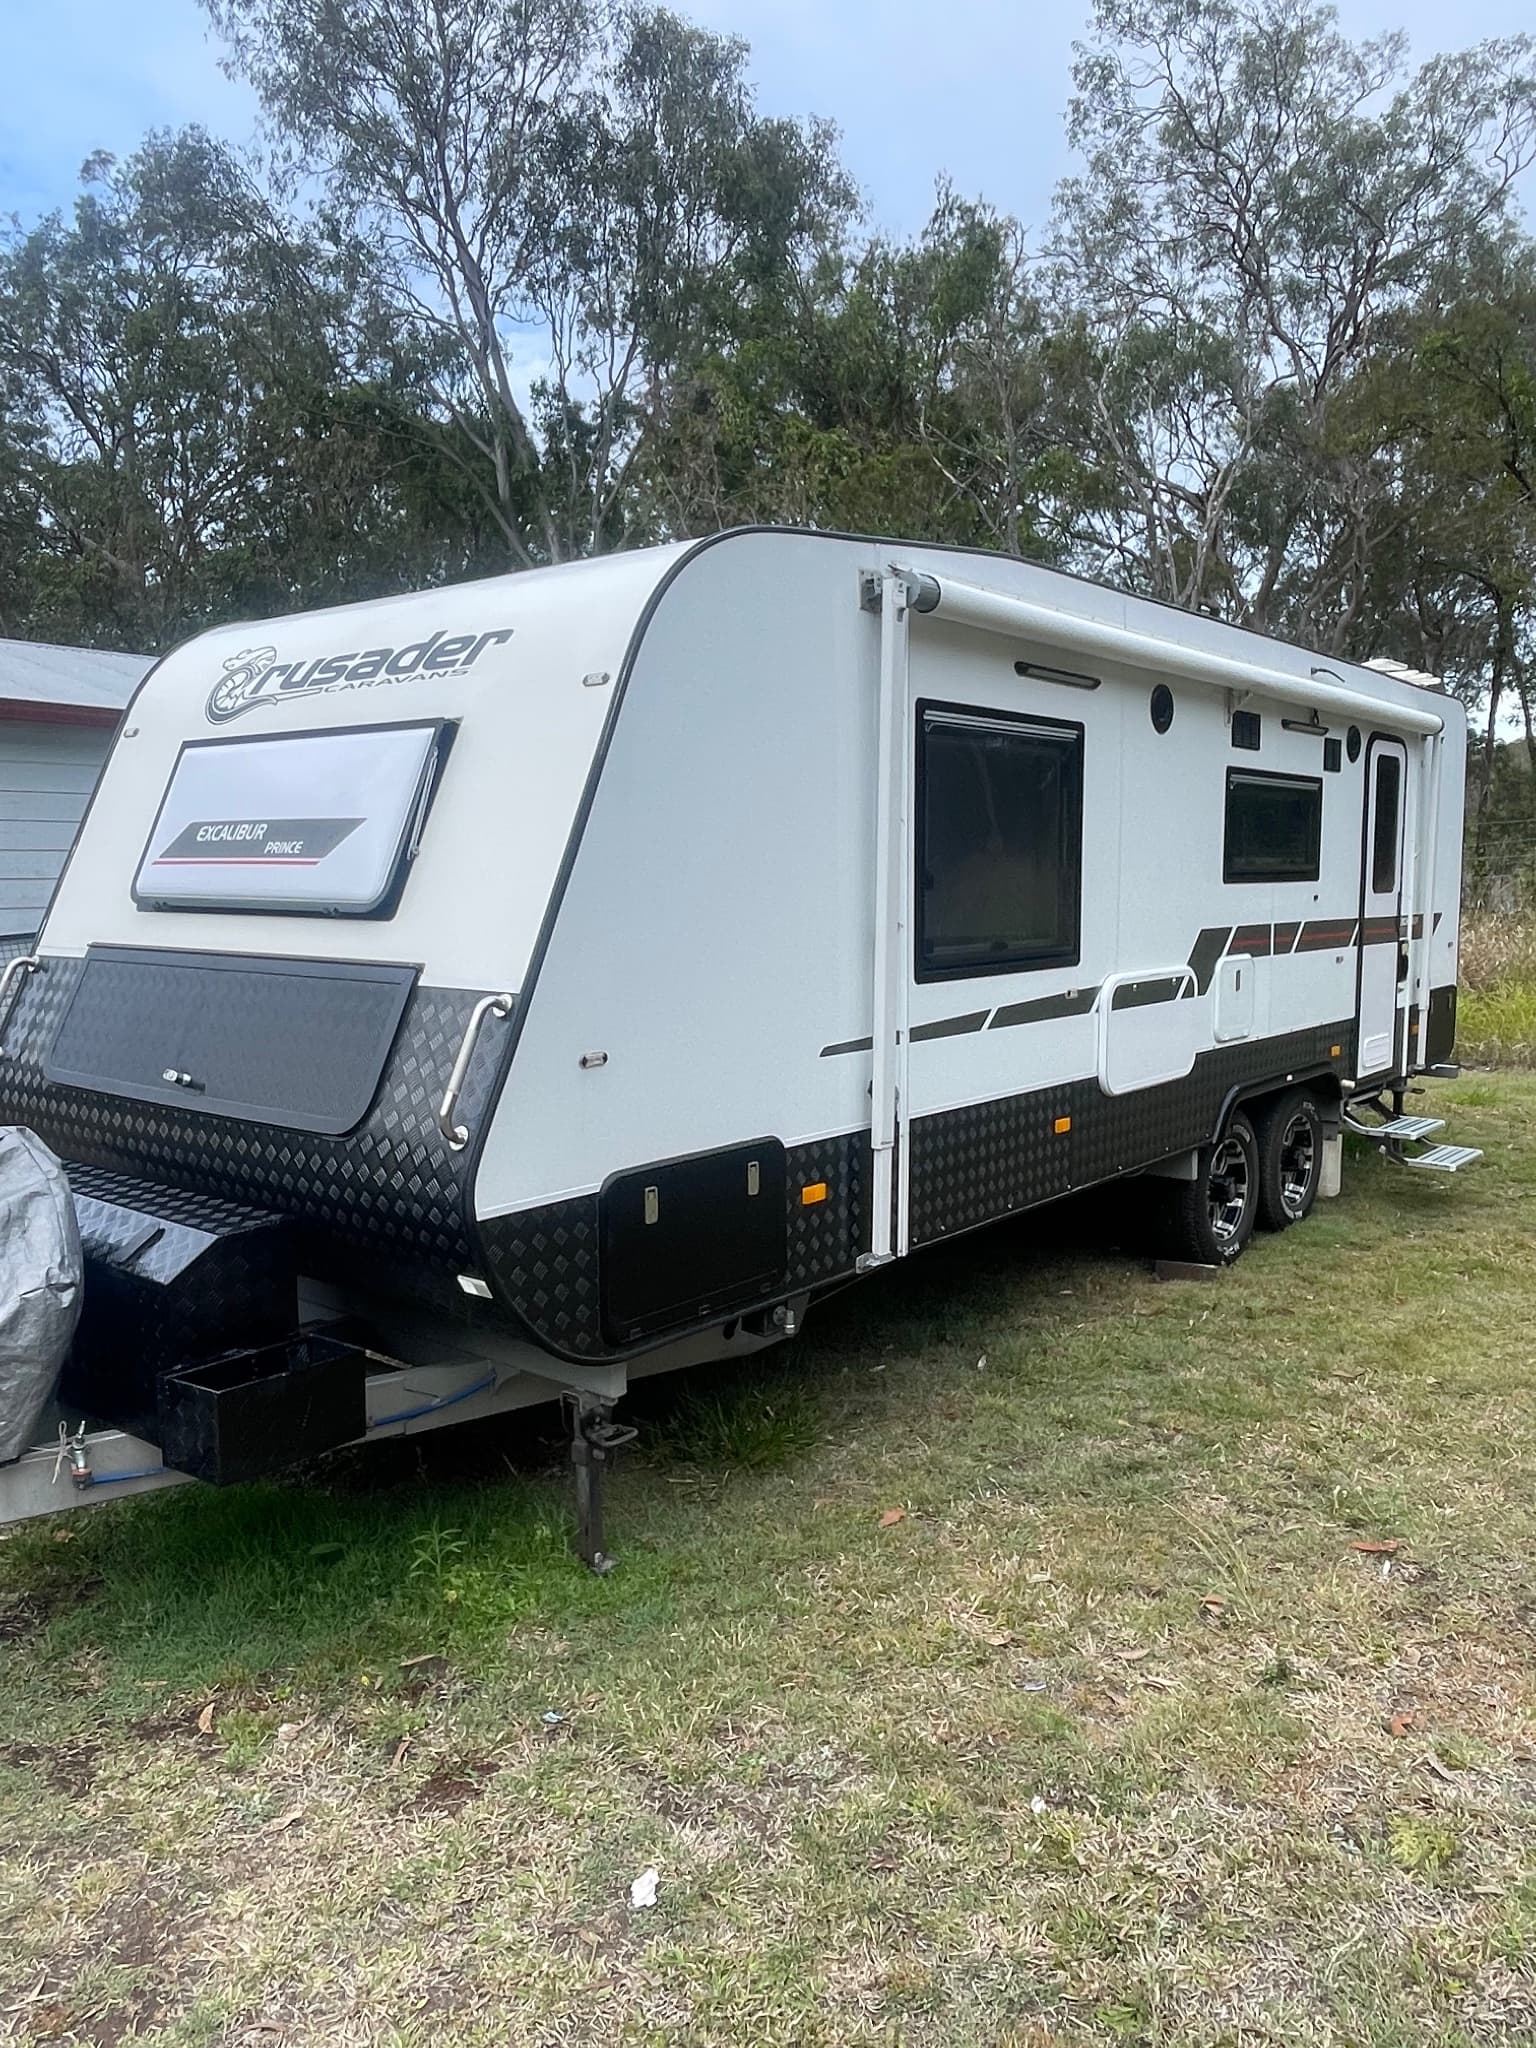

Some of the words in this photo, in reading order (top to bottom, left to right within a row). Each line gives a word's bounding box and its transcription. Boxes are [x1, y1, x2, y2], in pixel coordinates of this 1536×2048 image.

[321, 668, 470, 693] CARAVANS
[196, 823, 268, 842] EXCALIBUR
[263, 841, 304, 855] PRINCE
